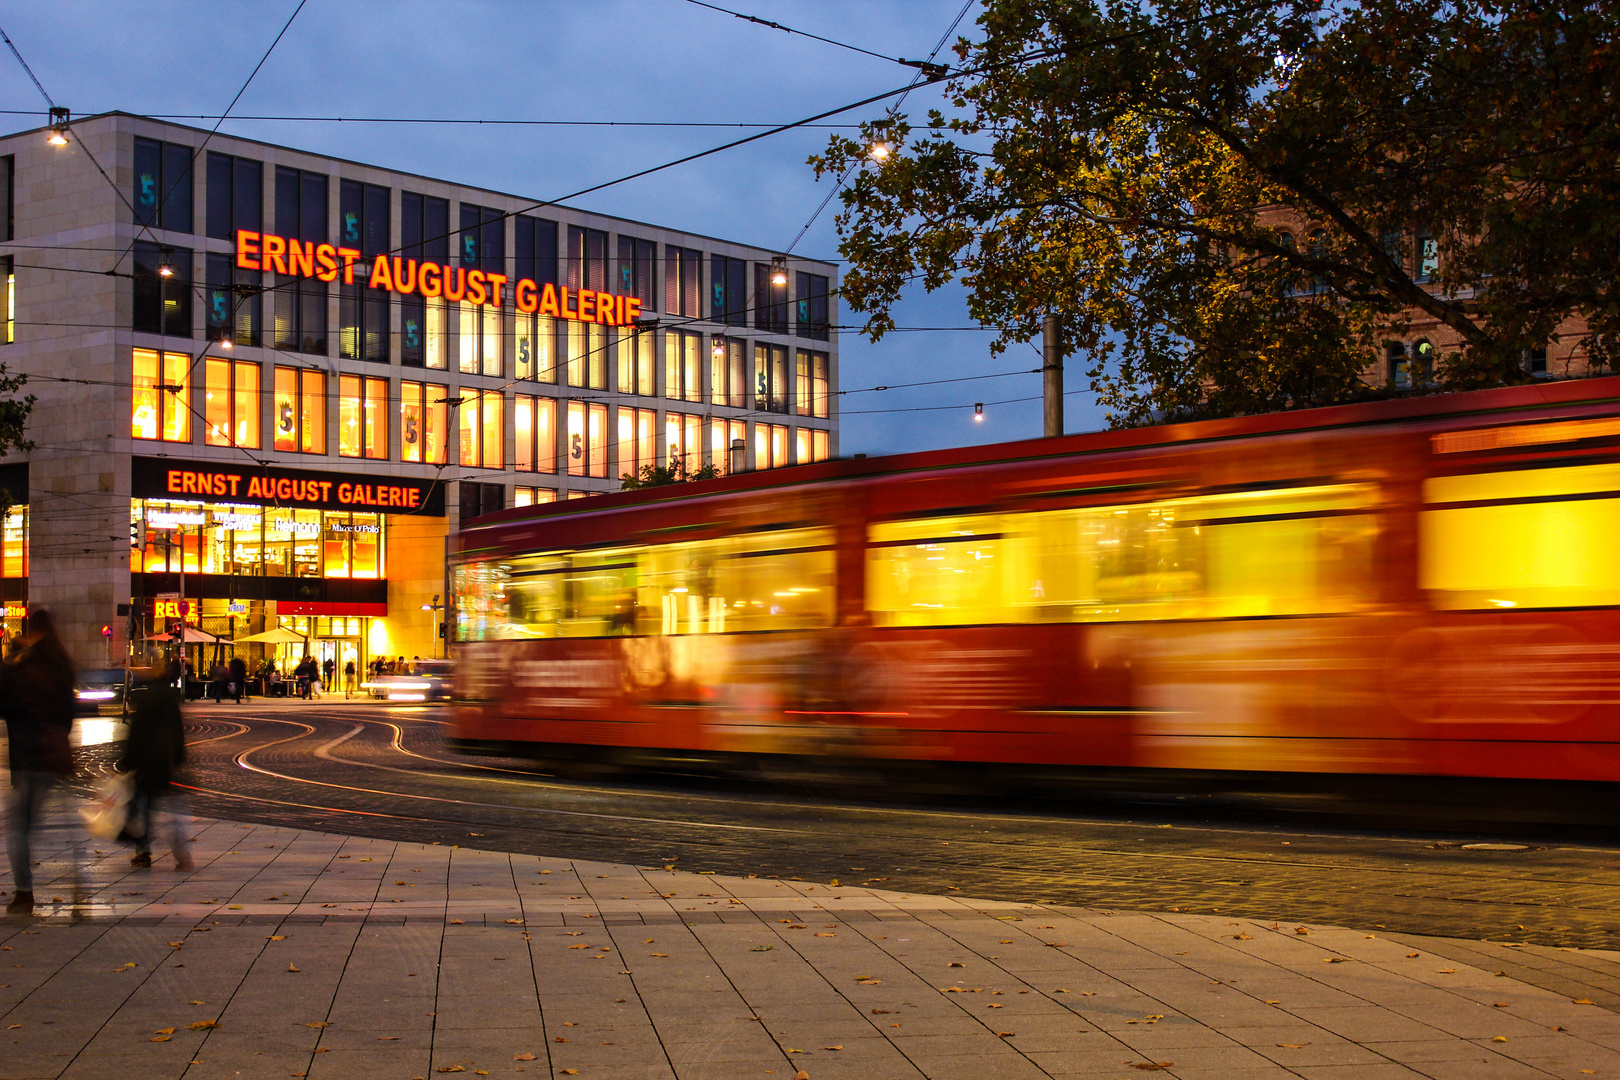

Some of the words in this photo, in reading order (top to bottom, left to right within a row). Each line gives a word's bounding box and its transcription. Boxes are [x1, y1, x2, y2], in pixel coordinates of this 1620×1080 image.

[345, 217, 358, 243] 5
[236, 229, 361, 285] ERNST
[369, 253, 507, 308] AUGUST
[515, 278, 642, 329] GALERIE
[406, 323, 419, 349] 5
[519, 341, 530, 364] 5
[757, 374, 767, 395] 5
[279, 404, 293, 432] 5
[406, 420, 418, 443] 5
[571, 435, 582, 459] 5
[167, 470, 242, 498] ERNST
[246, 476, 333, 504] AUGUST
[337, 482, 421, 508] GALERIE
